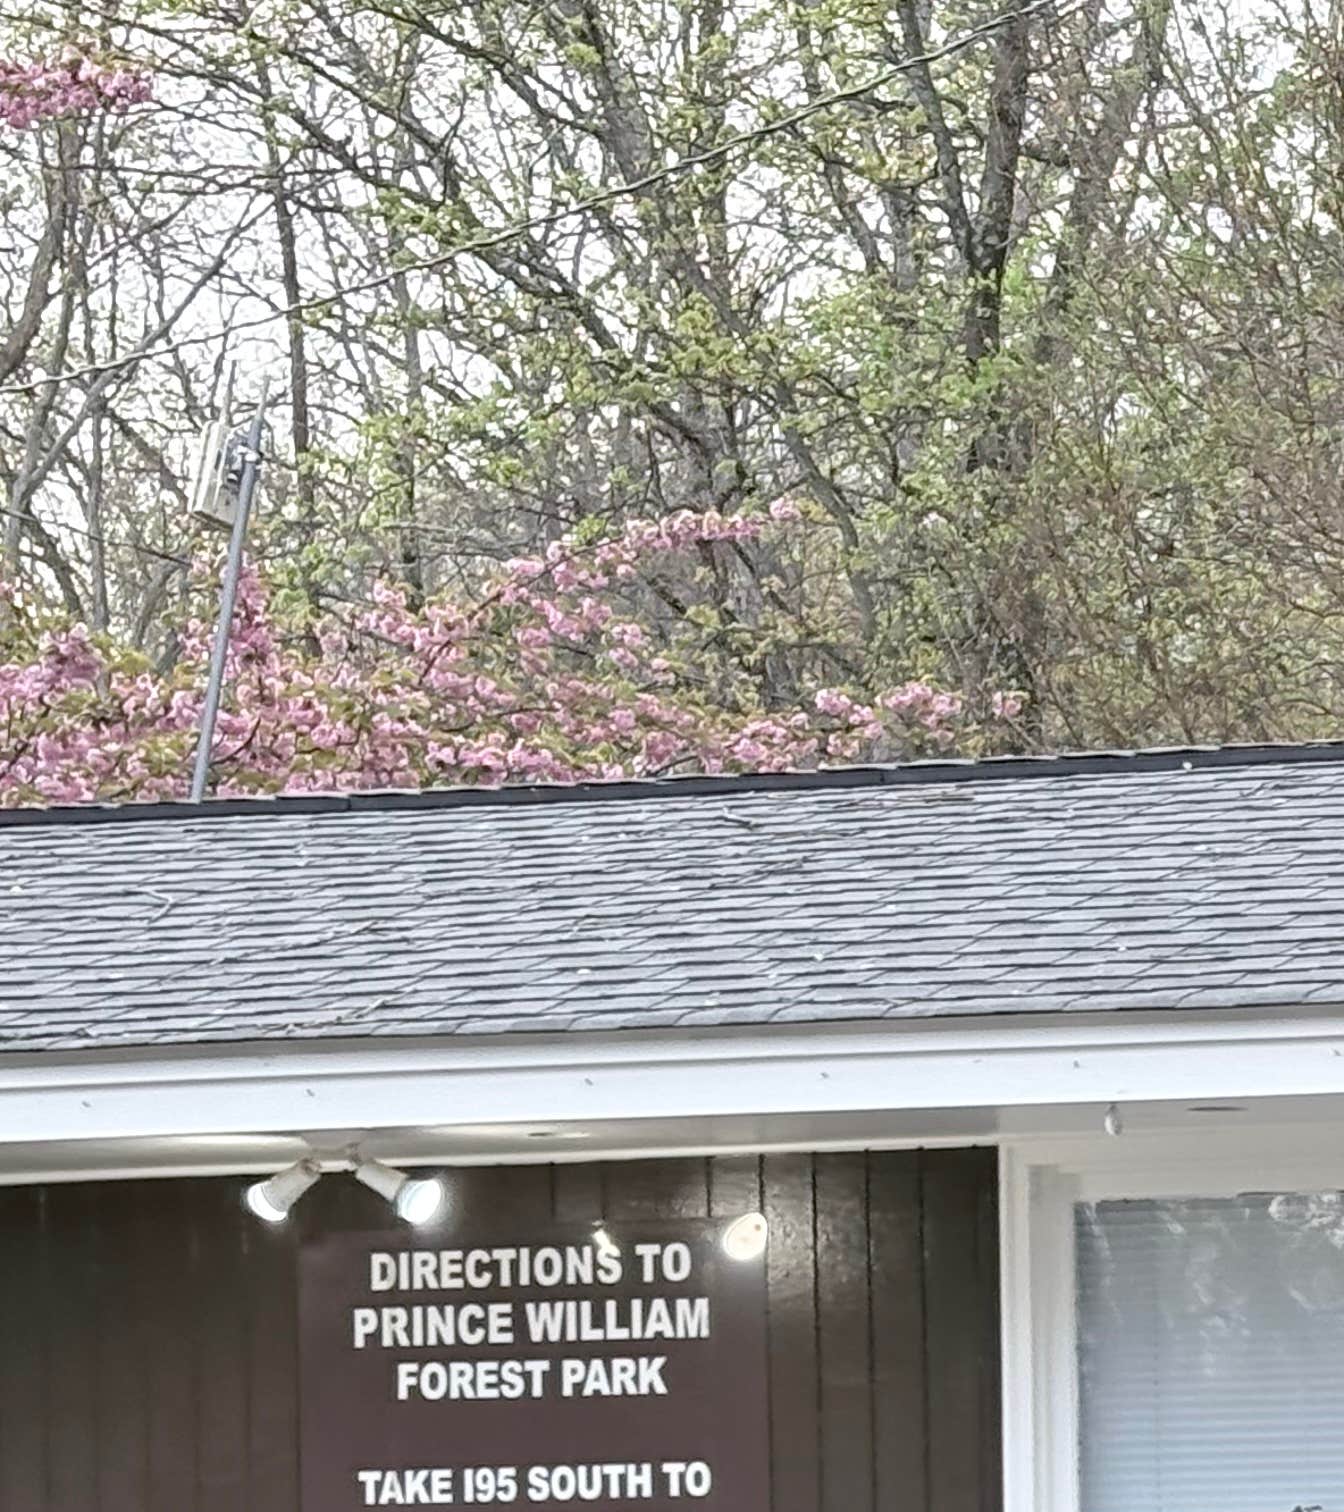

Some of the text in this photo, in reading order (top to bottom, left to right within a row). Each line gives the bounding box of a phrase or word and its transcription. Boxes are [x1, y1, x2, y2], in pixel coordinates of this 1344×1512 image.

[370, 1242, 692, 1292] DIRECTIONS TO
[353, 1297, 710, 1349] PRINCE WILLIAM
[397, 1356, 668, 1400] FOREST PARK
[358, 1461, 712, 1505] TAKE I95 SOUTH TO
